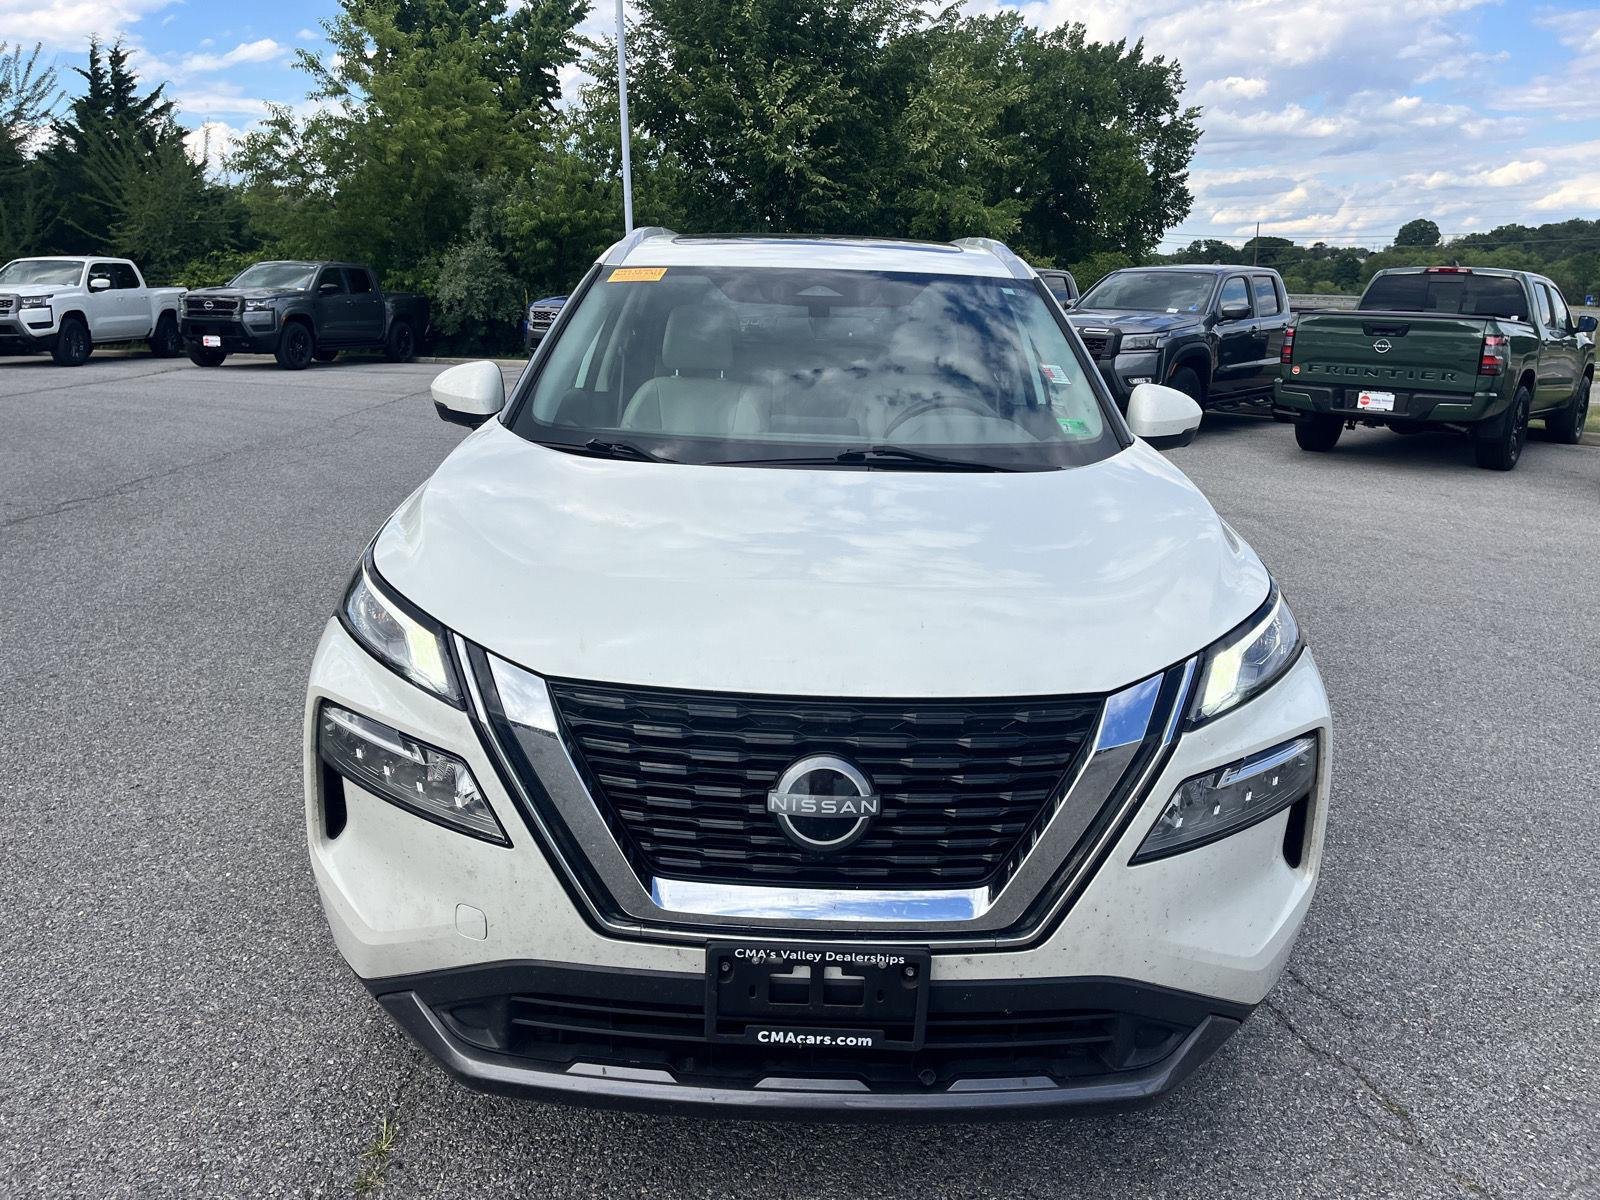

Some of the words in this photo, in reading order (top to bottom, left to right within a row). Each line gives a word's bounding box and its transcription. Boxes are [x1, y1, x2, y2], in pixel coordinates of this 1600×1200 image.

[1307, 364, 1457, 383] FRONTIER
[771, 796, 877, 814] NISSAN
[734, 948, 777, 959] CMA's
[780, 950, 822, 963] Valley
[825, 951, 905, 966] Dealerships
[757, 1031, 872, 1047] CMAcars.com
